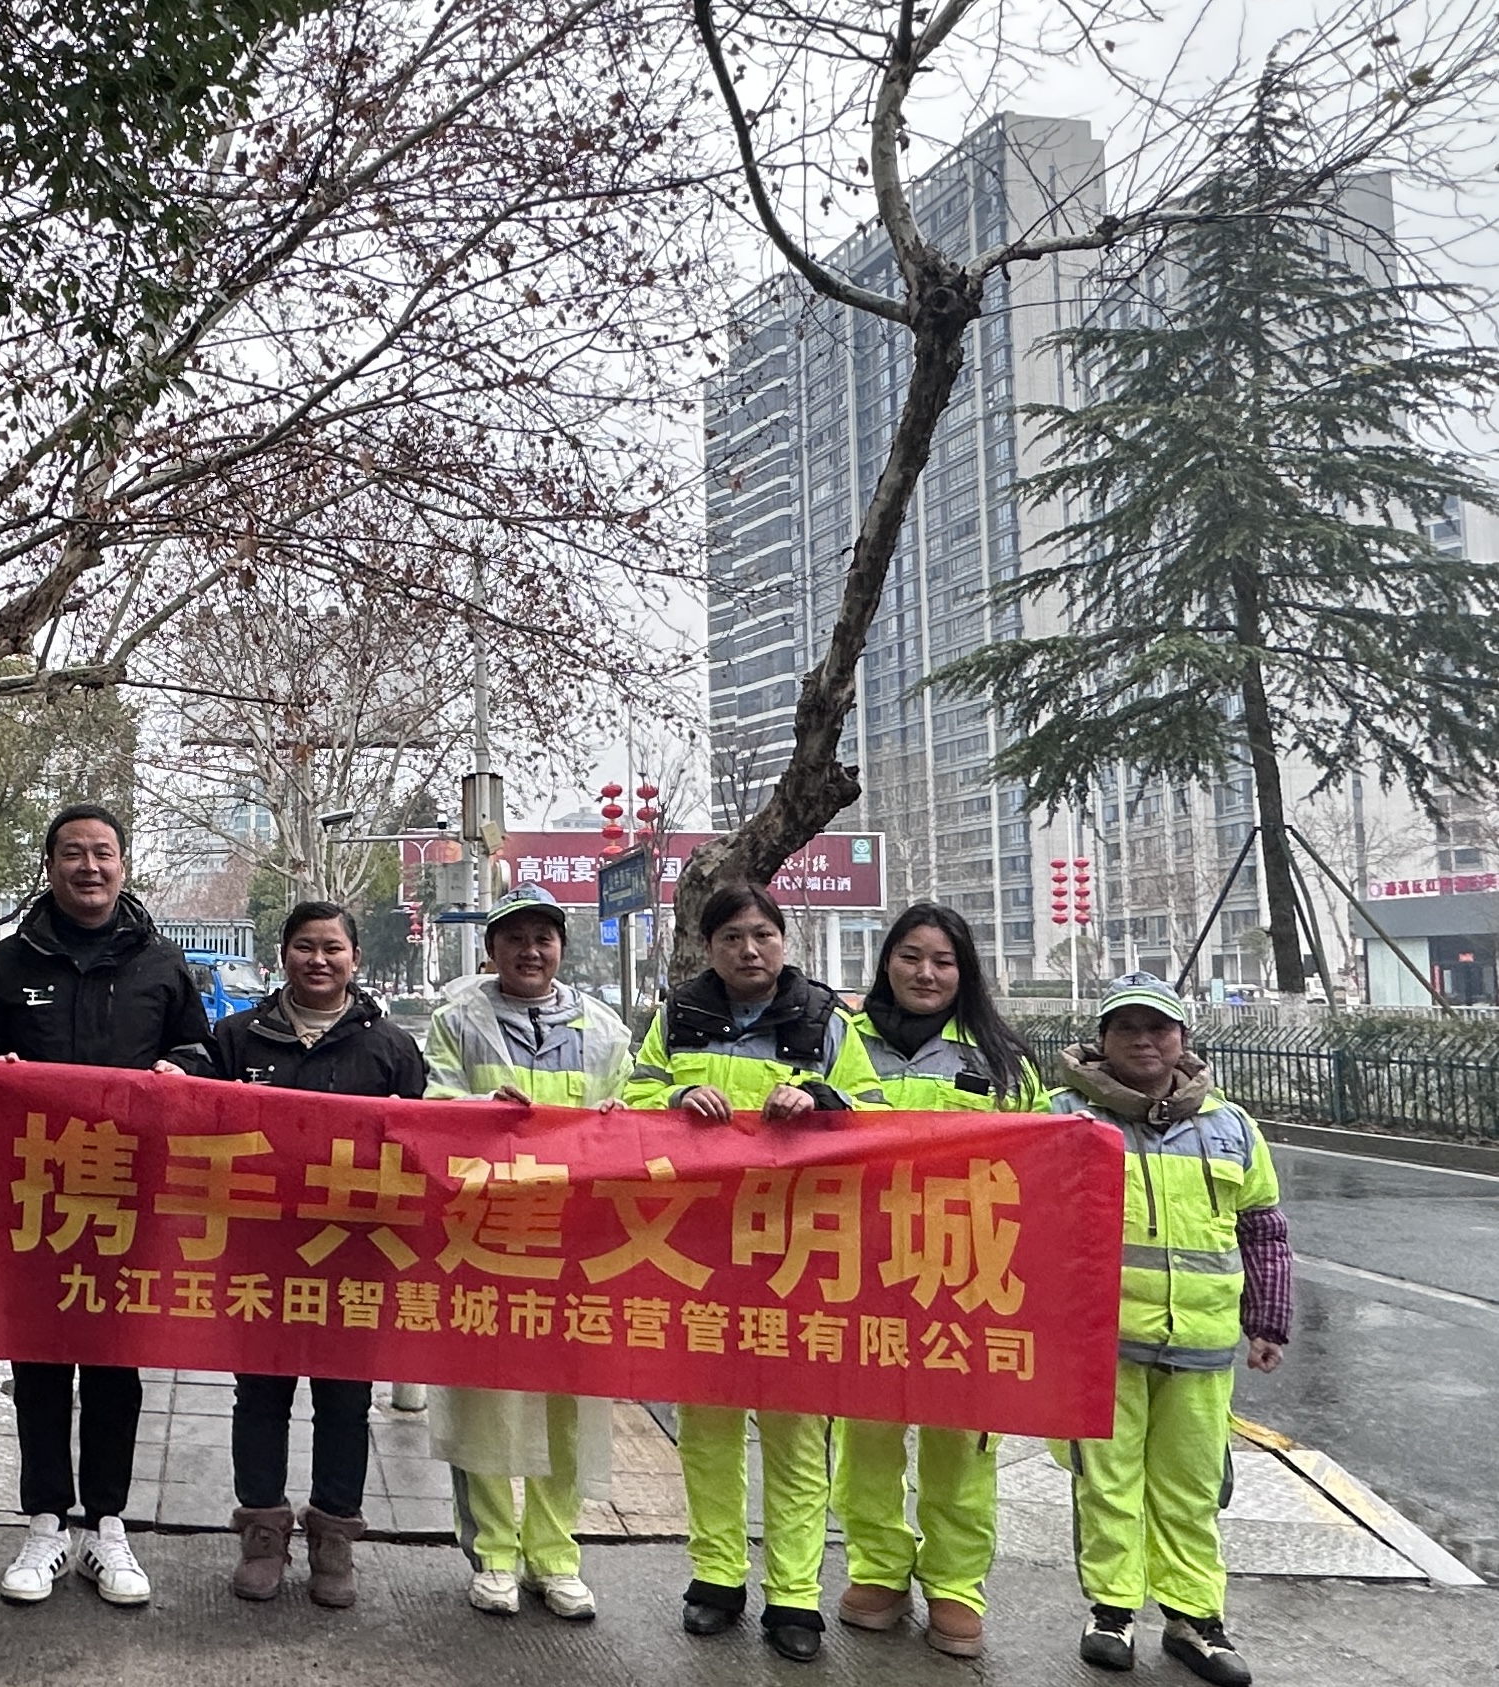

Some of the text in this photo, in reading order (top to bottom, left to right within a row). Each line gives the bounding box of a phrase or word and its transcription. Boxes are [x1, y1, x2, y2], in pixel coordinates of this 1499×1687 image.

[11, 1111, 1026, 1316] 携手共建文明城
[57, 1263, 1035, 1381] 九江玉禾田智慧城市运营管理有限公司
